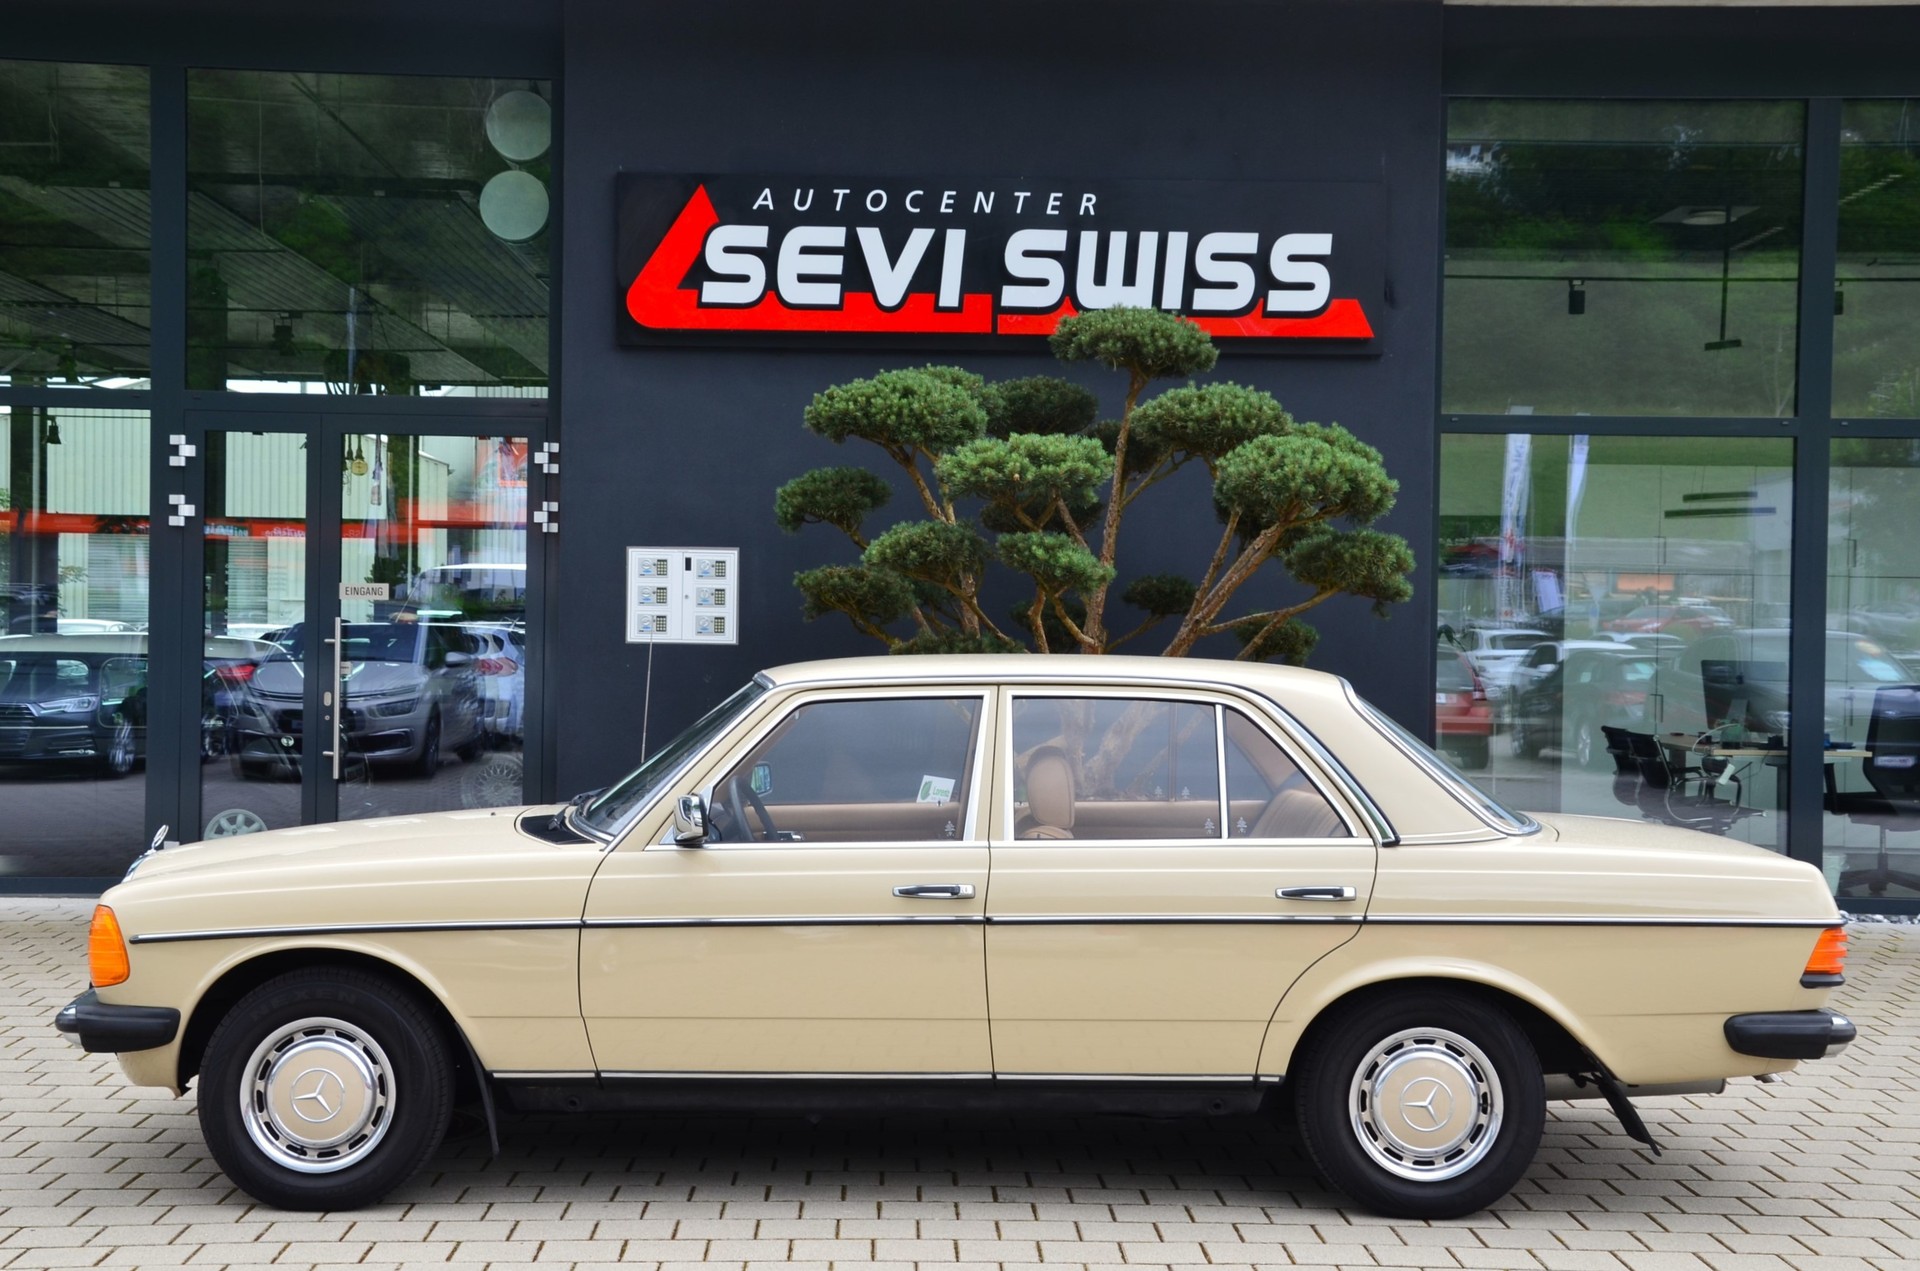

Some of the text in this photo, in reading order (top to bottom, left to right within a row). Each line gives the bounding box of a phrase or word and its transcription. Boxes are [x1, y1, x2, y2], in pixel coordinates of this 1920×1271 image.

[753, 186, 1099, 216] AUTOCENTER
[701, 224, 1333, 313] SEVI SWISS
[345, 586, 383, 596] EINGANG
[250, 988, 358, 1022] NEXEN
